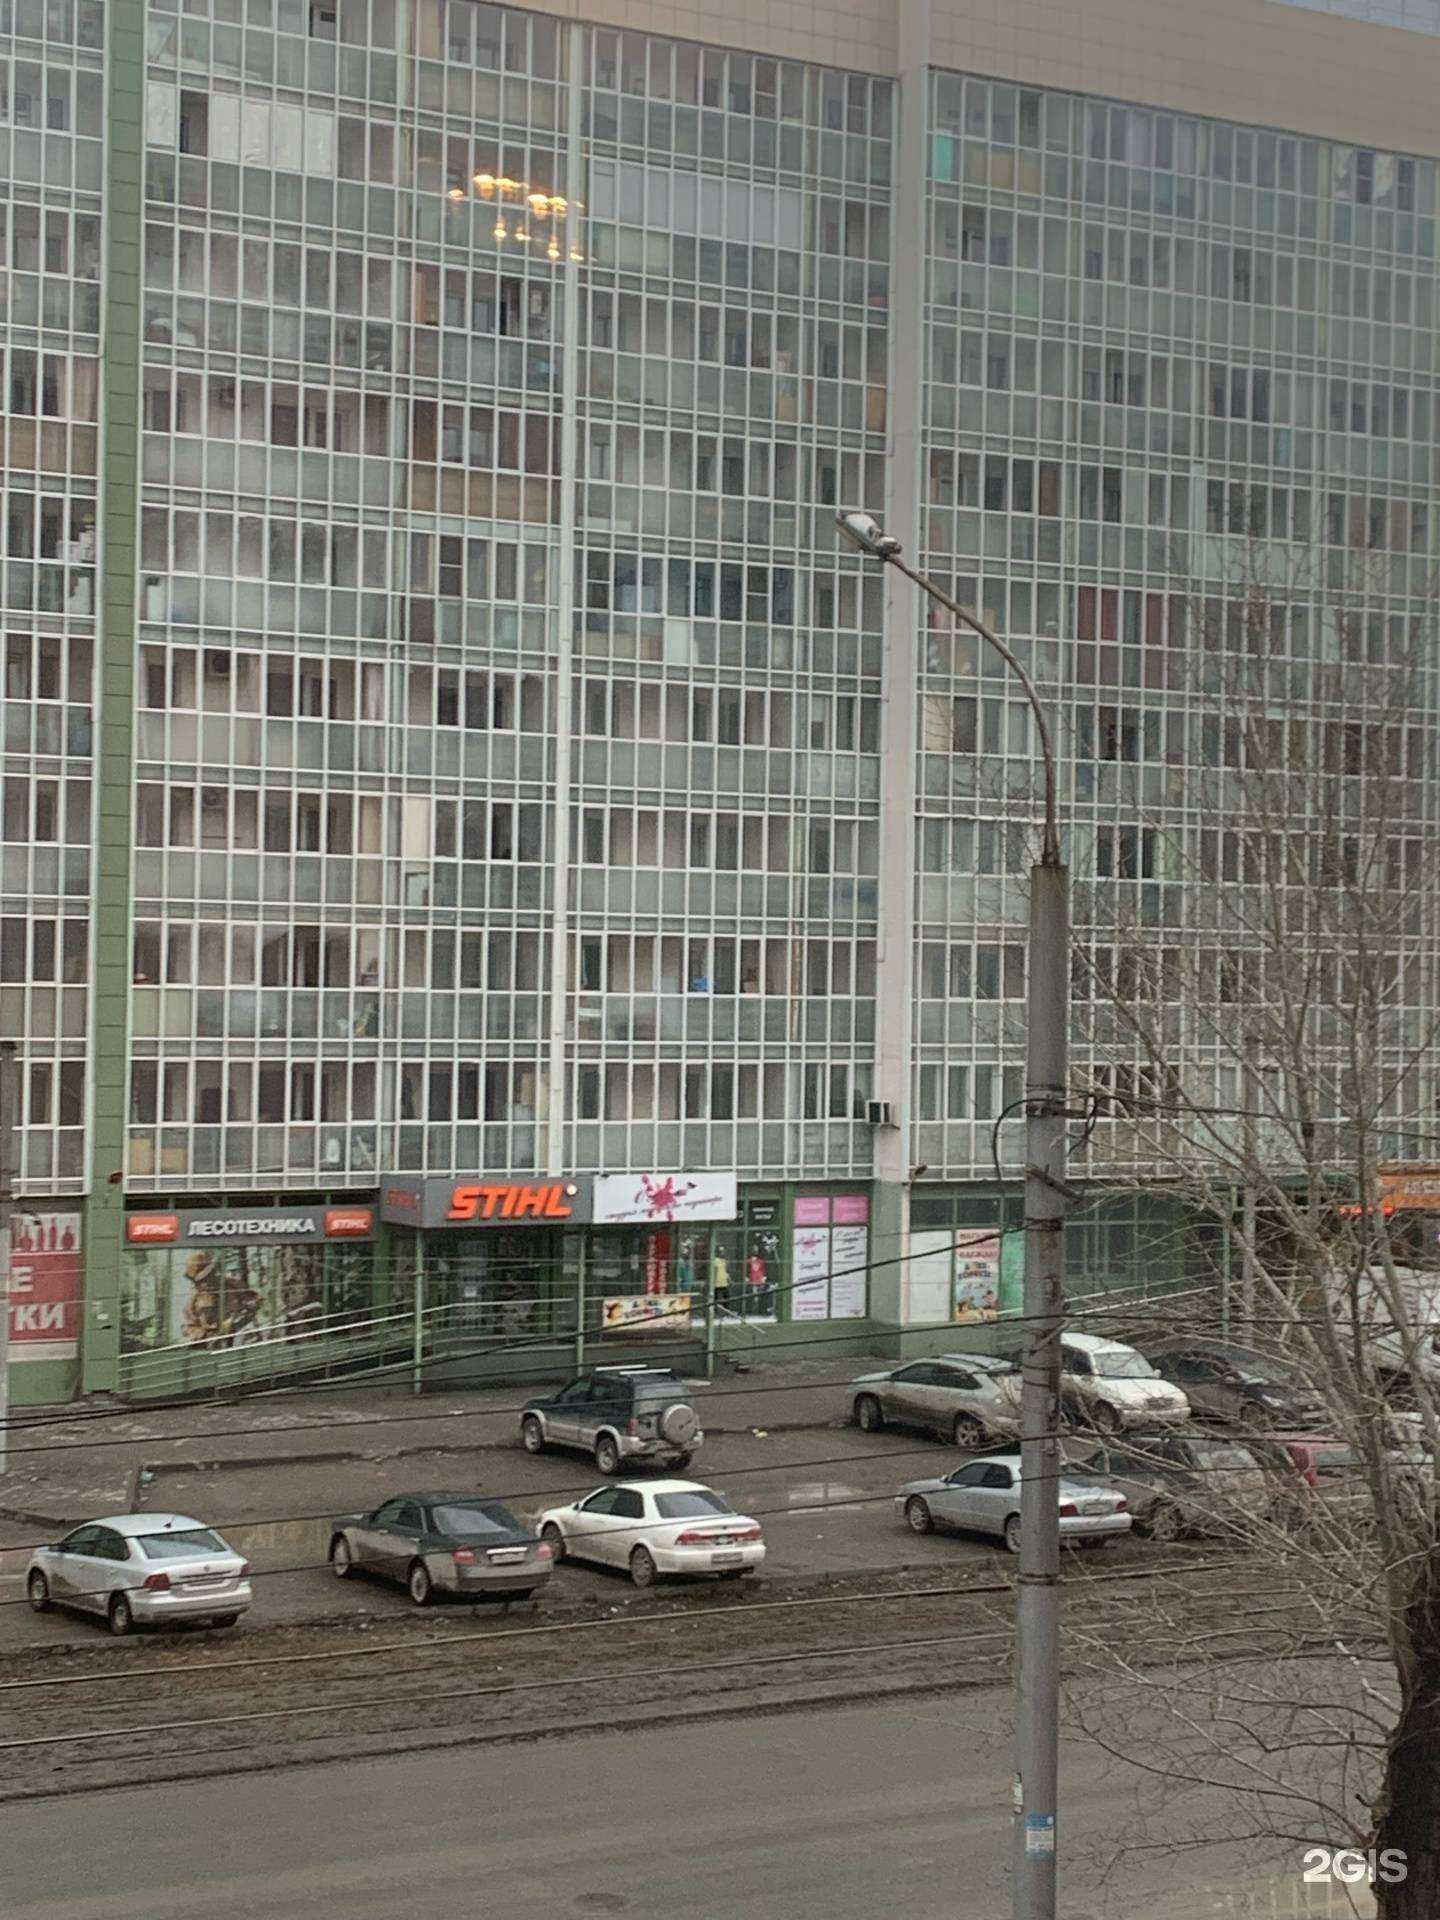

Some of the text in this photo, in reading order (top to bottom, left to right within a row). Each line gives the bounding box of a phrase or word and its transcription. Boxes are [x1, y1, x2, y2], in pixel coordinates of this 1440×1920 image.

[446, 1184, 572, 1220] STIHL
[187, 1217, 316, 1236] ЛЕСОТЕХНИКА
[8, 1302, 65, 1332] КИ
